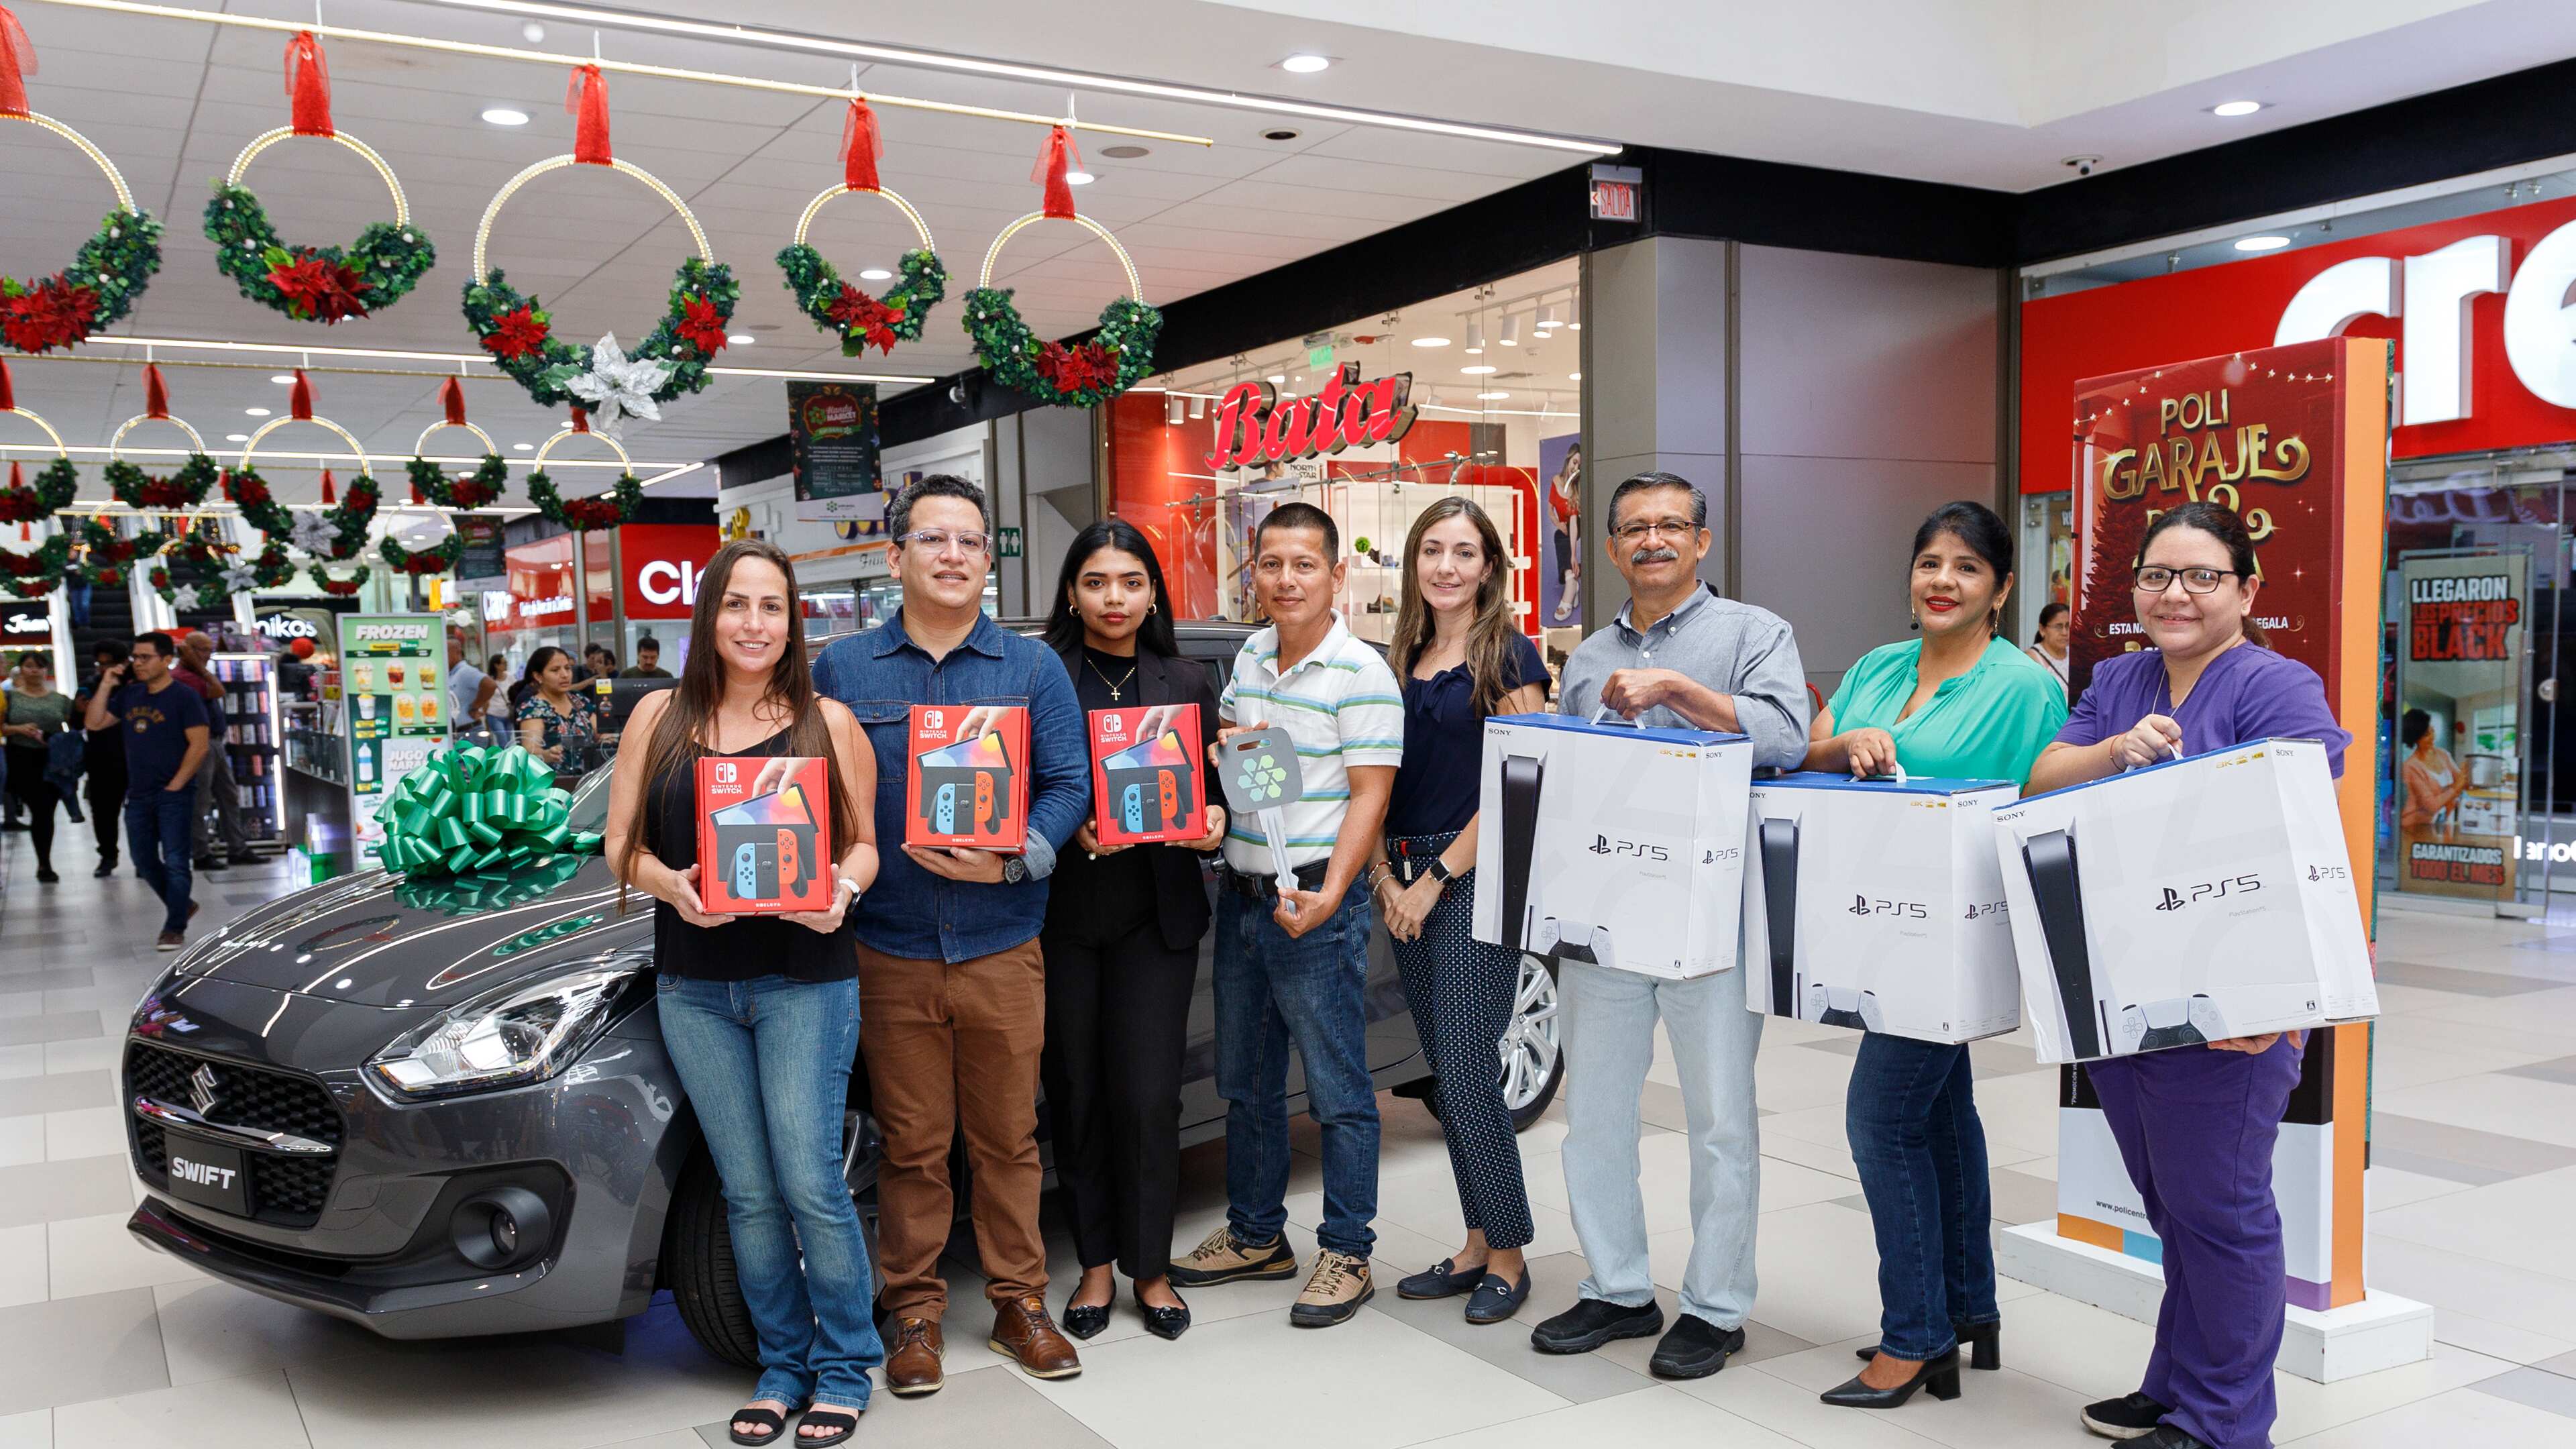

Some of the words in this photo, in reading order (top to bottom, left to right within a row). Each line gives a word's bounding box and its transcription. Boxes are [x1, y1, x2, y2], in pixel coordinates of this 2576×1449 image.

[1205, 362, 1405, 470] Bata
[2160, 388, 2229, 435] POLI
[2103, 423, 2310, 503] GARAJE
[2411, 576, 2508, 603] LLEGARON
[2438, 600, 2518, 624] PRECIOS
[356, 624, 429, 640] FROZEN
[2109, 622, 2132, 635] ESTA
[2413, 623, 2507, 659] BLACK
[1488, 728, 1511, 736] SONY
[388, 750, 425, 761] JUGO
[2275, 749, 2294, 757] SONY
[1957, 800, 1979, 808] SONY
[1996, 810, 2026, 822] SONY
[1617, 841, 1668, 861] PS5
[1716, 848, 1738, 861] PS5
[2412, 843, 2503, 865] GARANTIZADOS
[2321, 867, 2345, 879] PS5
[2470, 865, 2504, 885] MES
[2190, 873, 2261, 902] PS5
[1876, 900, 1927, 918] PS5
[172, 1157, 235, 1189] SWIFT
